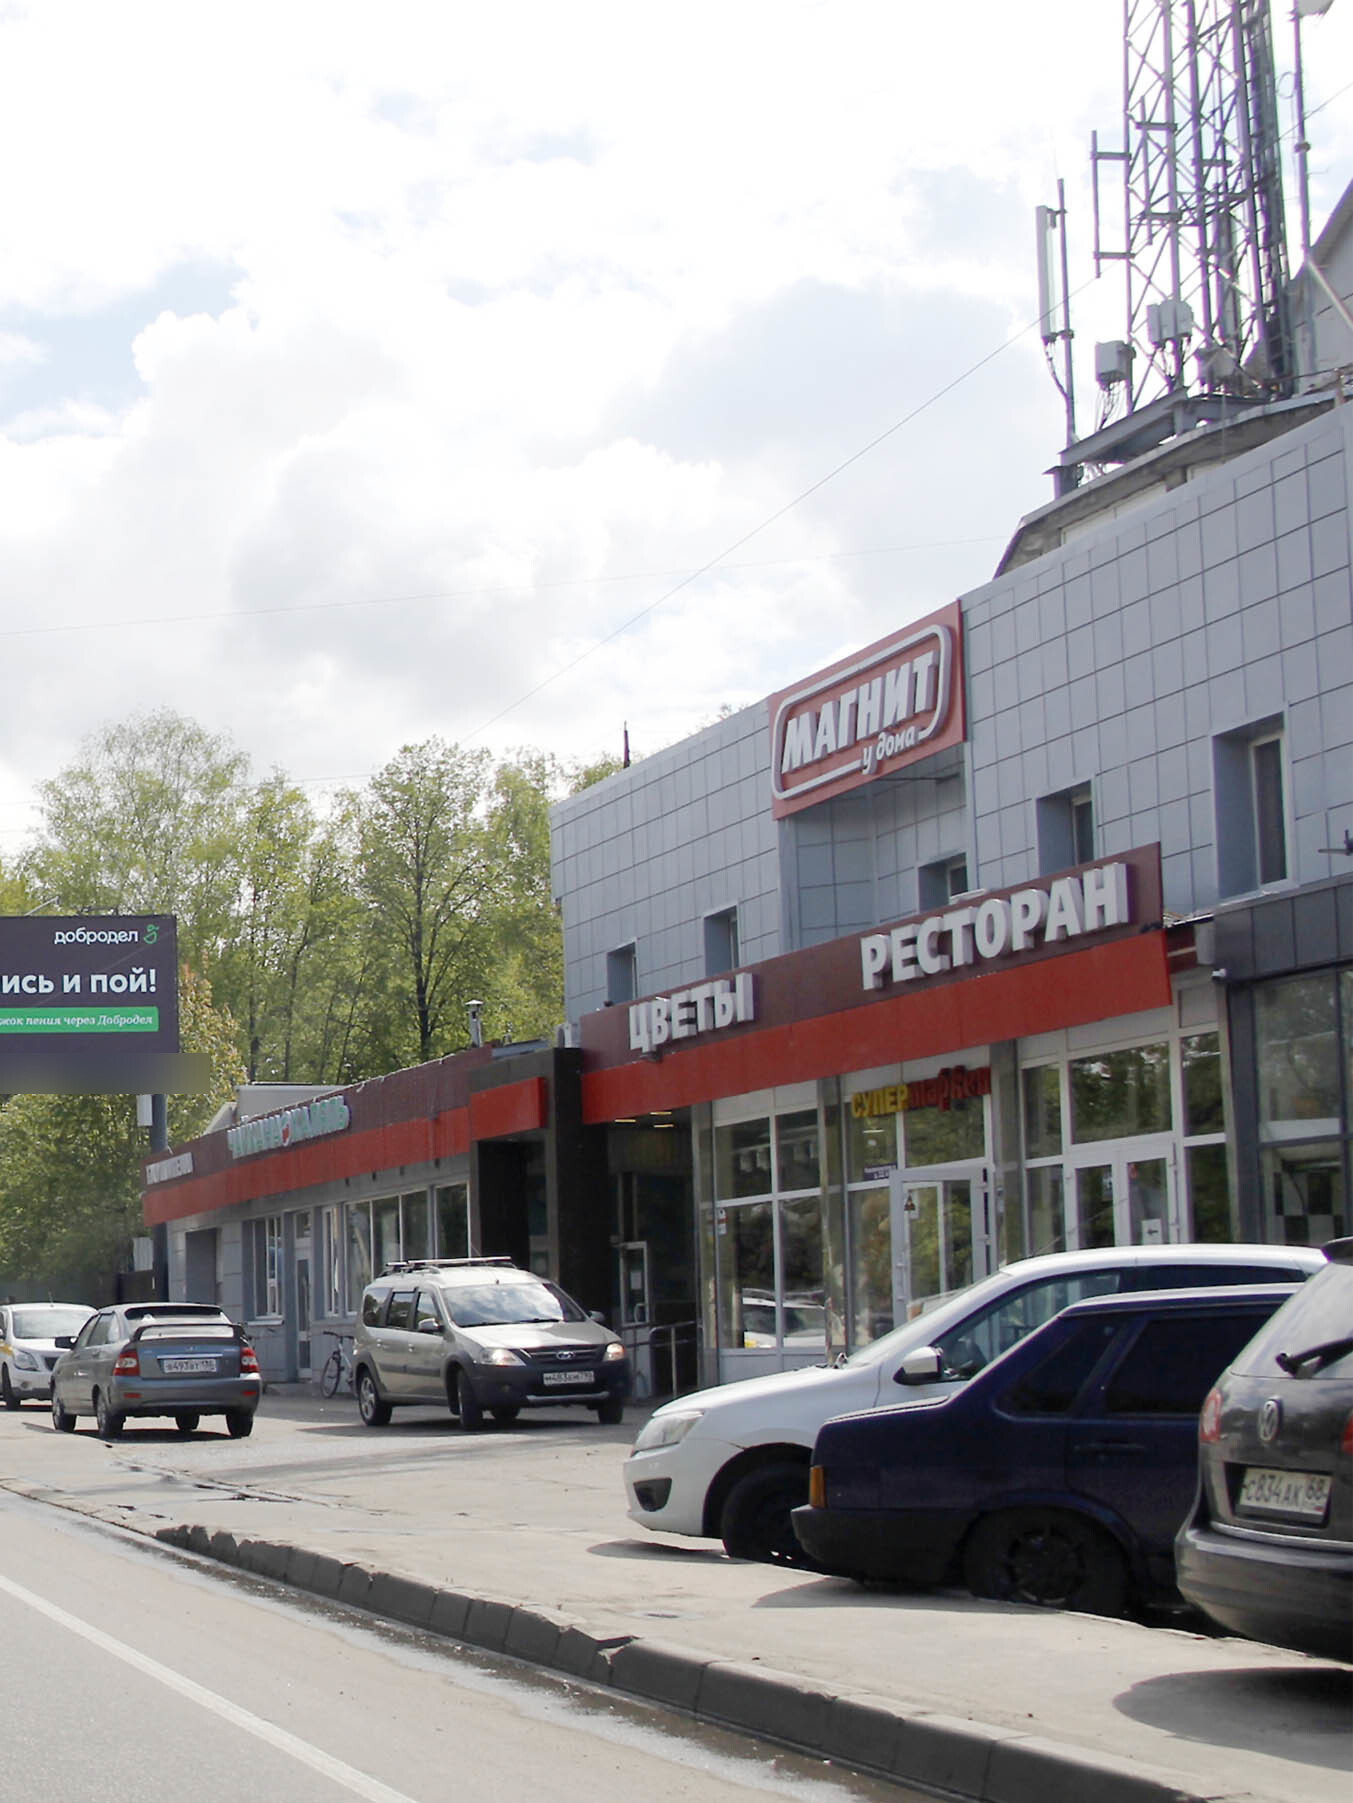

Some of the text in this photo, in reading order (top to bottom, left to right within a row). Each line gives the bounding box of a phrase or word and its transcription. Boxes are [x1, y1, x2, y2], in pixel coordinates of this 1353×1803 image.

[781, 651, 936, 775] МАГНИТ
[876, 726, 917, 761] дома
[54, 926, 139, 945] добродел
[860, 862, 1130, 990] РЕСТОРАН
[62, 974, 81, 993] и
[90, 967, 157, 993] пой!
[64, 1016, 96, 1028] через
[628, 972, 755, 1053] ЦВЕТЫ
